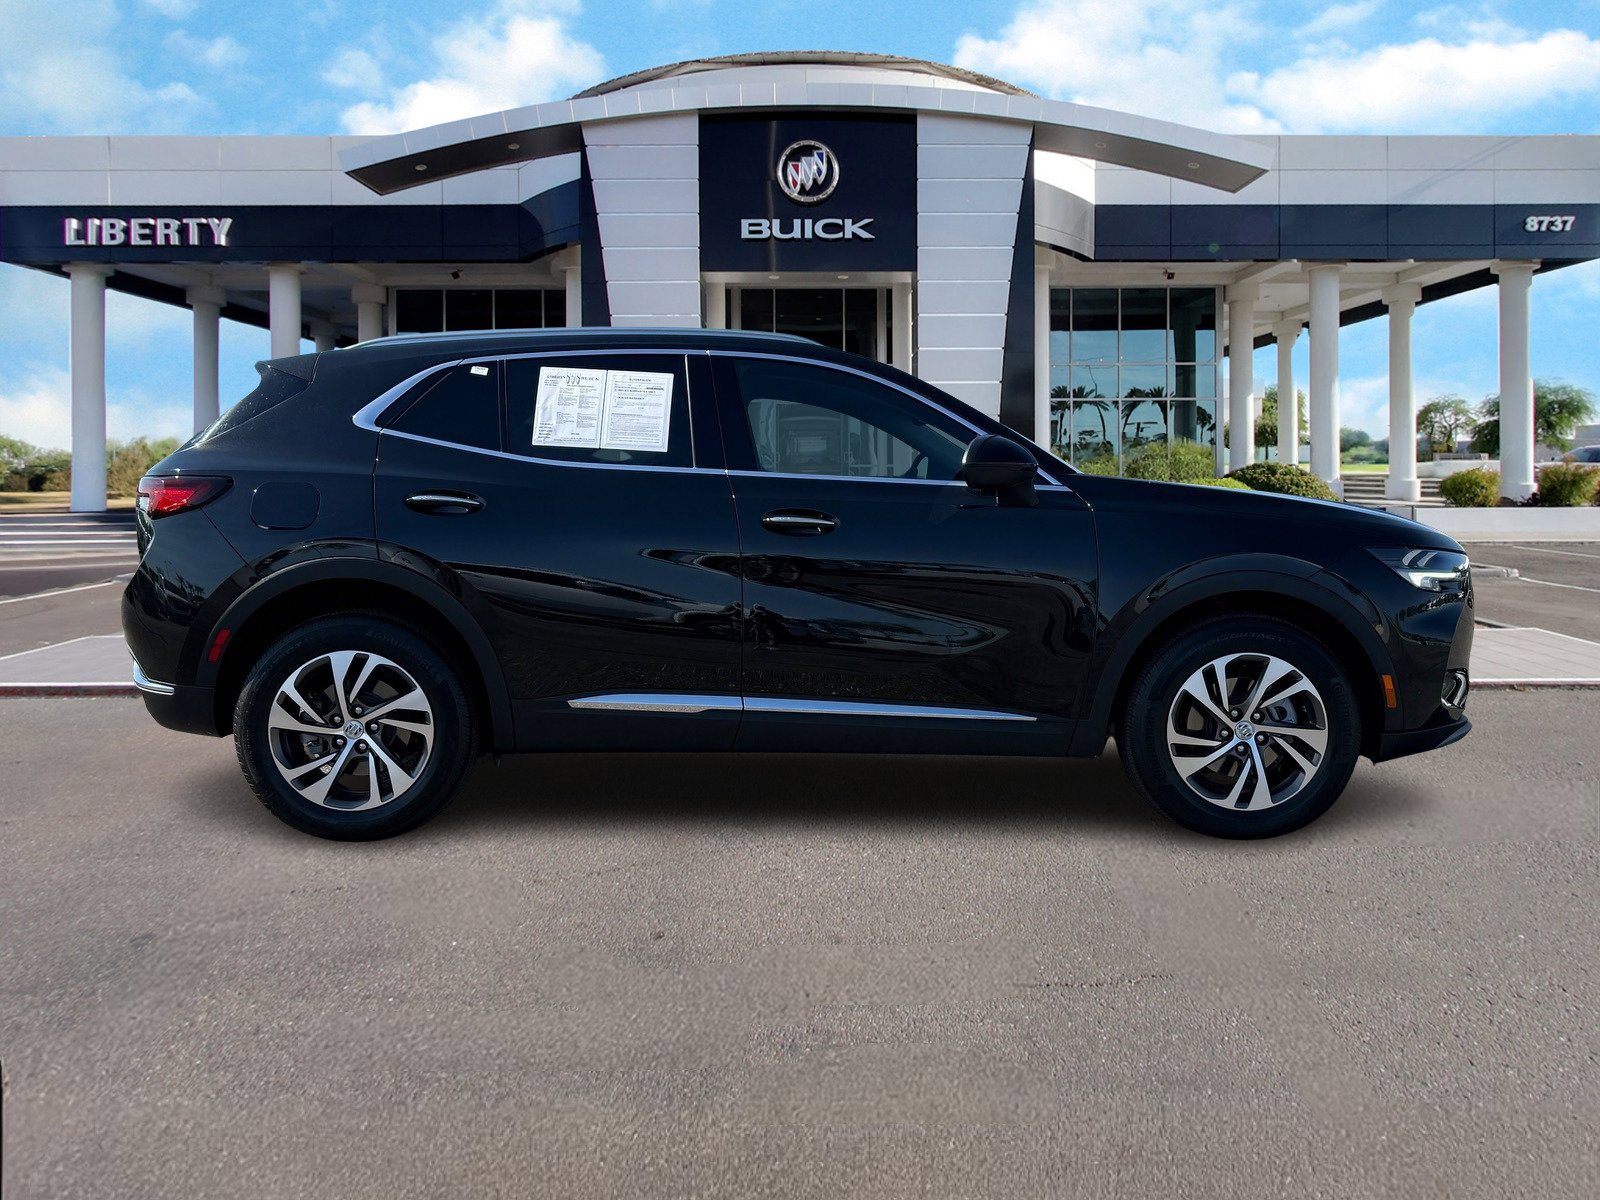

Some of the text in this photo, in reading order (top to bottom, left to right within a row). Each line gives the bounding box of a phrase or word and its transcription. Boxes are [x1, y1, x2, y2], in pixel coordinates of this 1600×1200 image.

[64, 217, 233, 247] LIBERTY
[740, 218, 876, 240] BUICK
[1525, 215, 1576, 232] 8737
